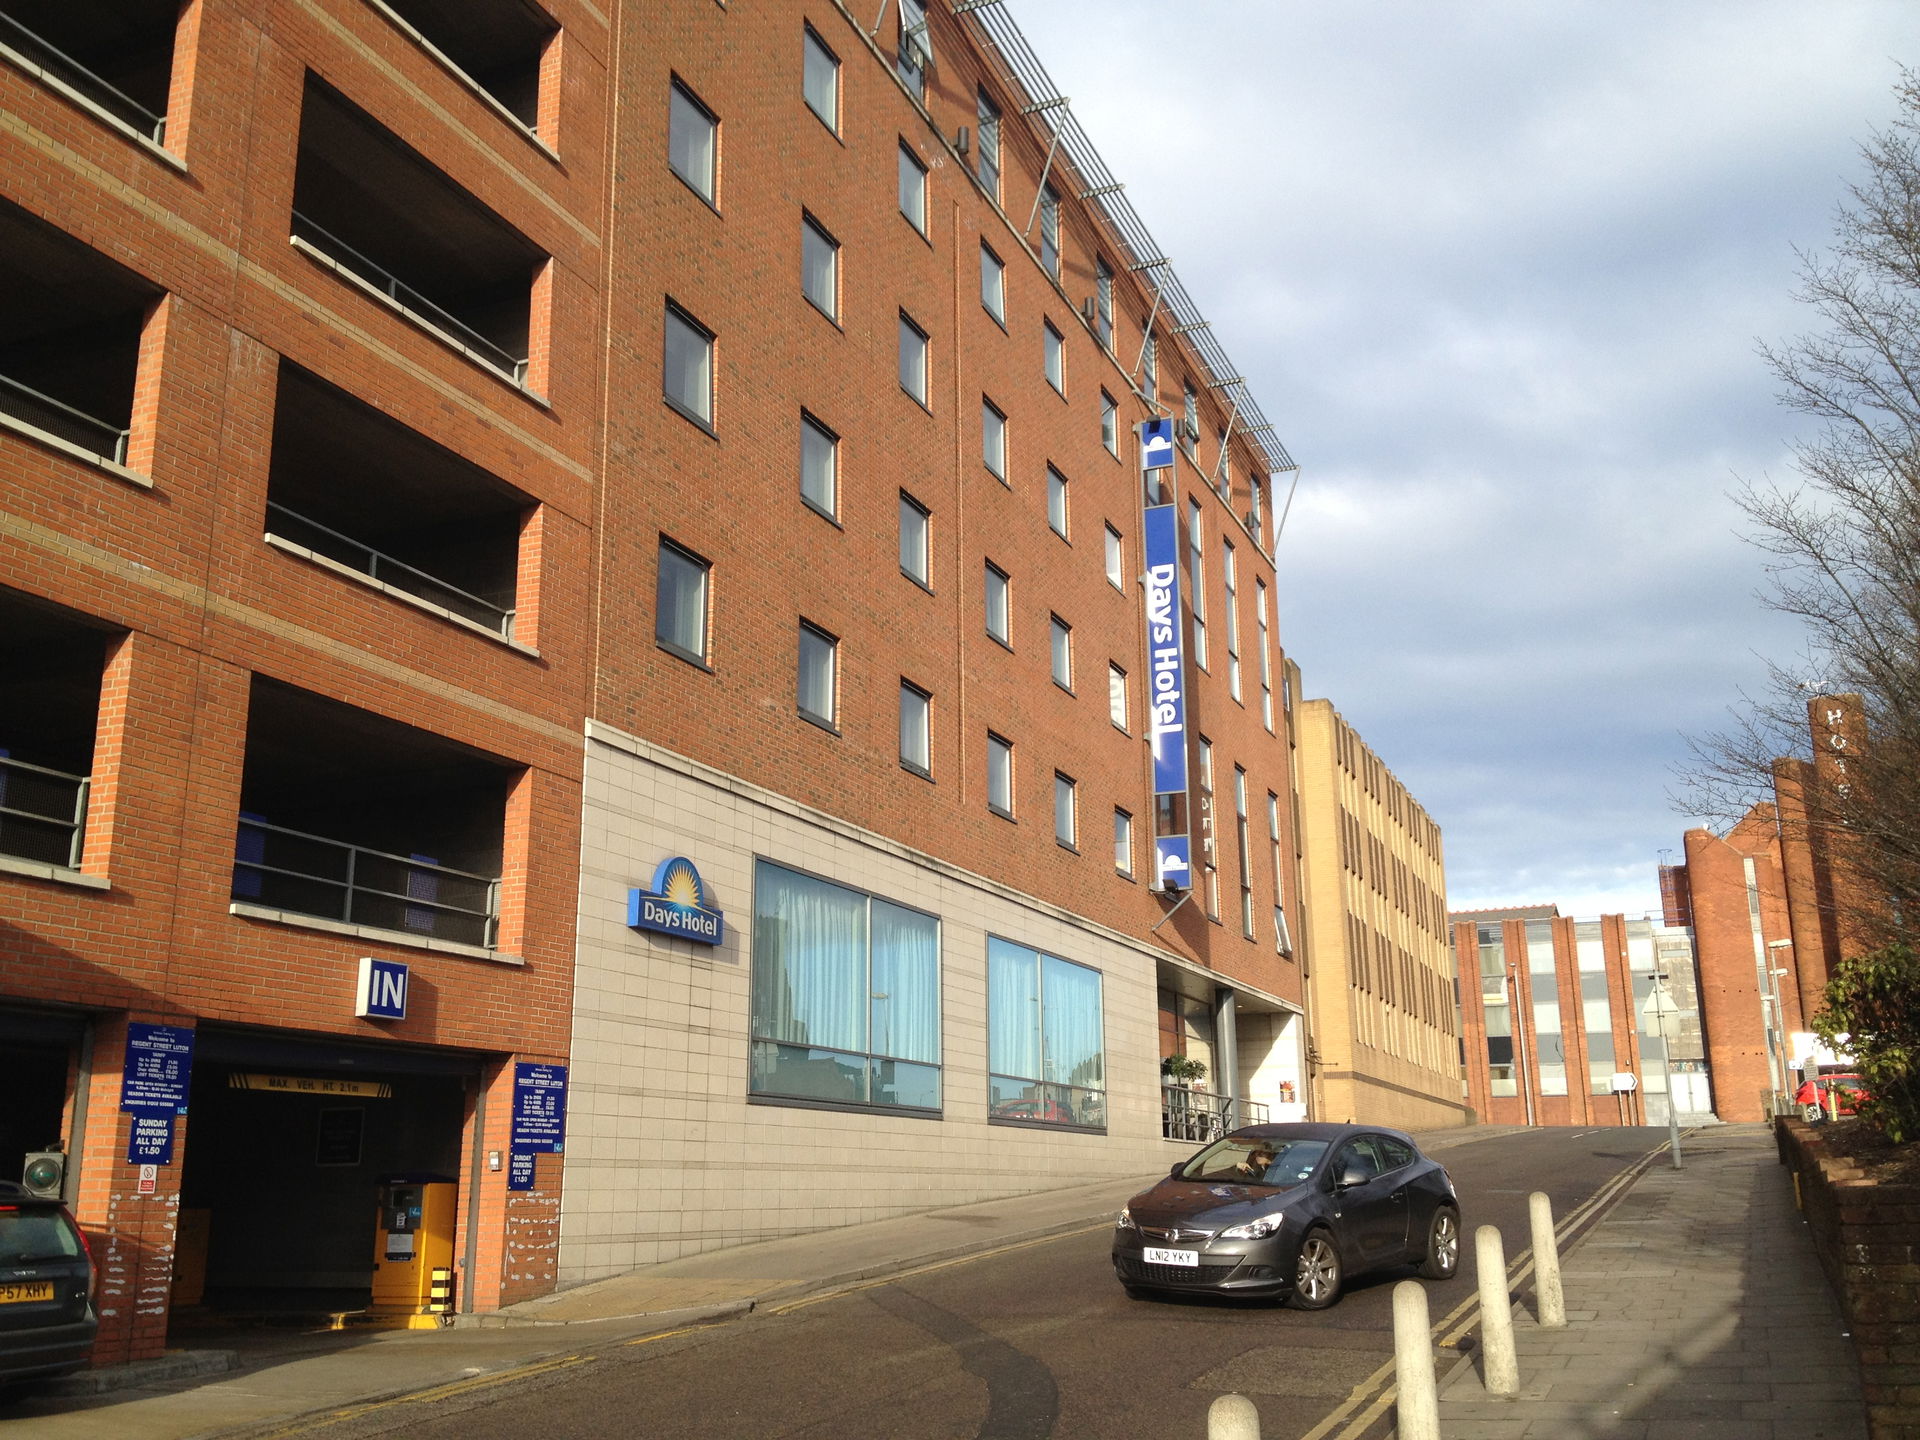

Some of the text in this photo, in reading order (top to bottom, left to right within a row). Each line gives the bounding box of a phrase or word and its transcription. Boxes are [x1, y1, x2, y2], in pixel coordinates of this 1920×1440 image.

[1150, 563, 1183, 734] Days Hotel
[644, 901, 717, 936] Days Hotel
[371, 969, 404, 1009] IN
[153, 1041, 172, 1049] STREET
[172, 1043, 189, 1051] LUTON
[268, 1077, 290, 1089] MAX.
[138, 1118, 168, 1127] SUNDAY
[136, 1128, 168, 1137] PARKING
[135, 1137, 167, 1146] ALL DAY
[1149, 1250, 1192, 1263] LN12 YKY
[25, 1282, 48, 1298] XHY
